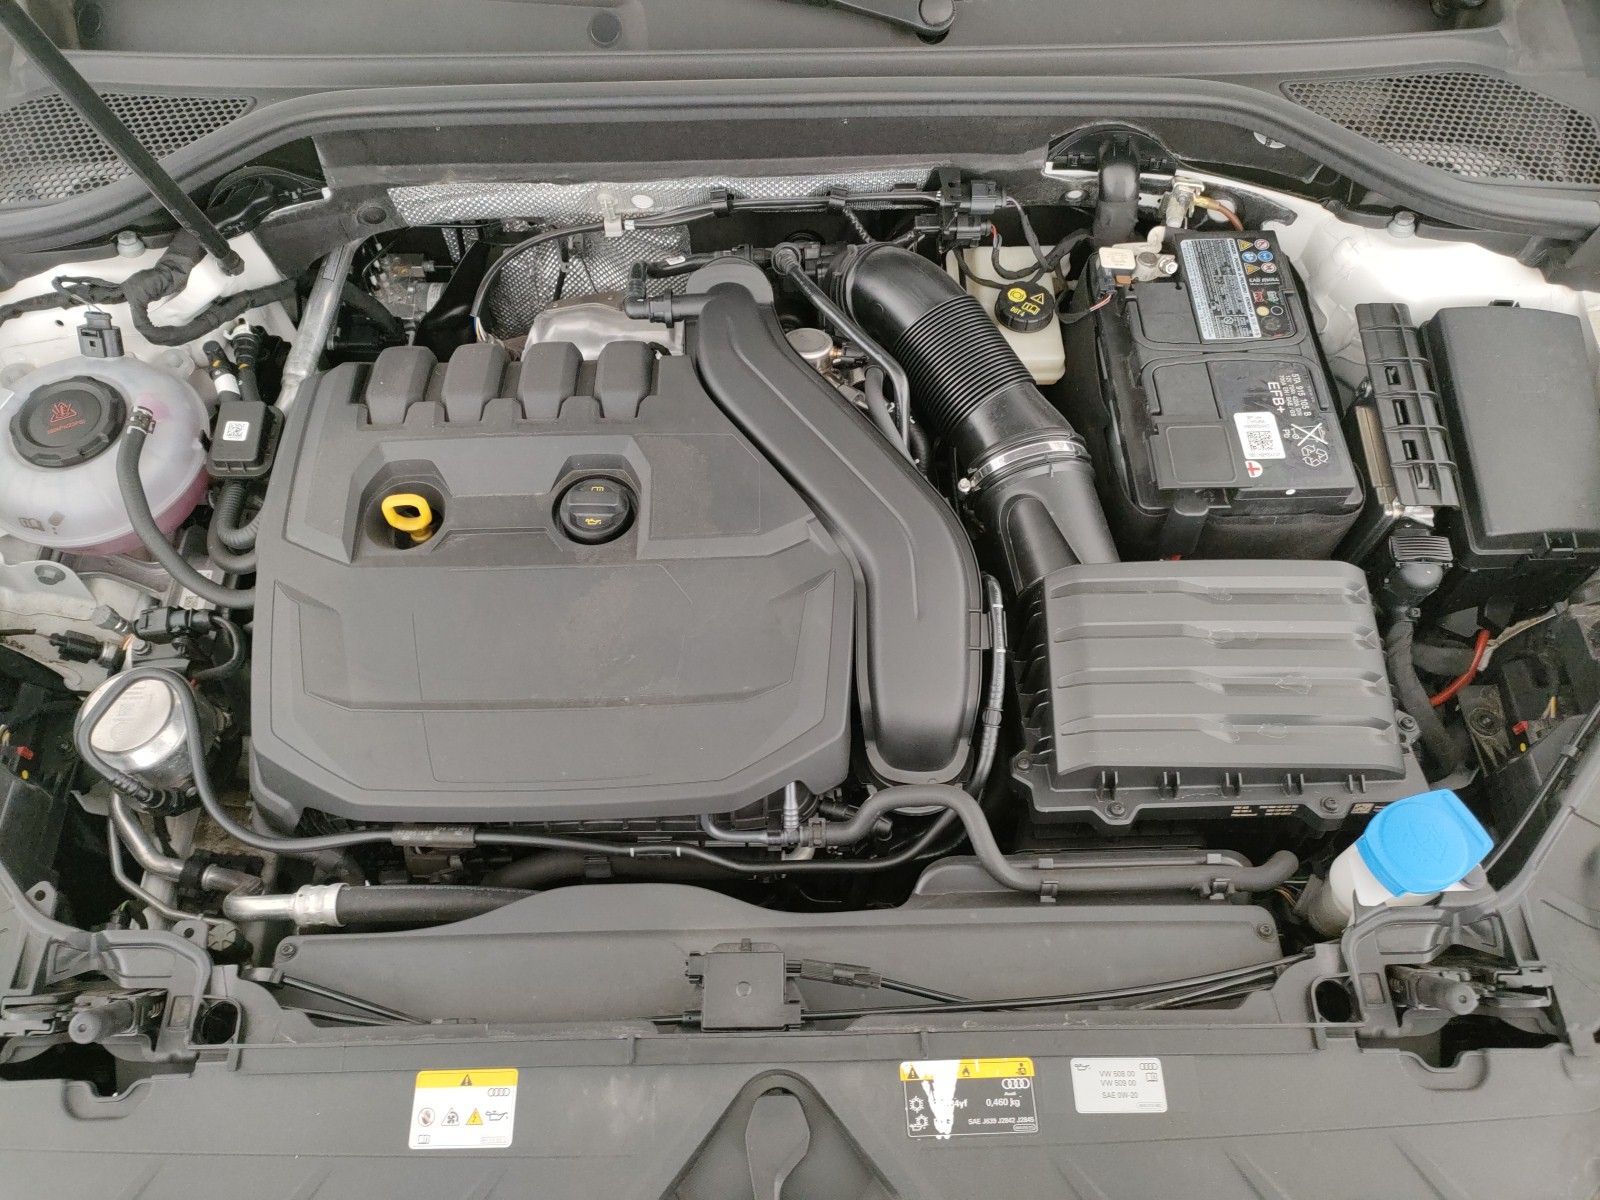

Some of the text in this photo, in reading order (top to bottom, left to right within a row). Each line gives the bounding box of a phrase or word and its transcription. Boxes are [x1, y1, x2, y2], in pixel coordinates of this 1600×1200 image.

[1296, 385, 1306, 396] 915
[1267, 382, 1286, 413] EFB+
[1300, 398, 1310, 410] 105
[1102, 1091, 1139, 1099] SAE 0W-20
[985, 1098, 1009, 1107] 0,460
